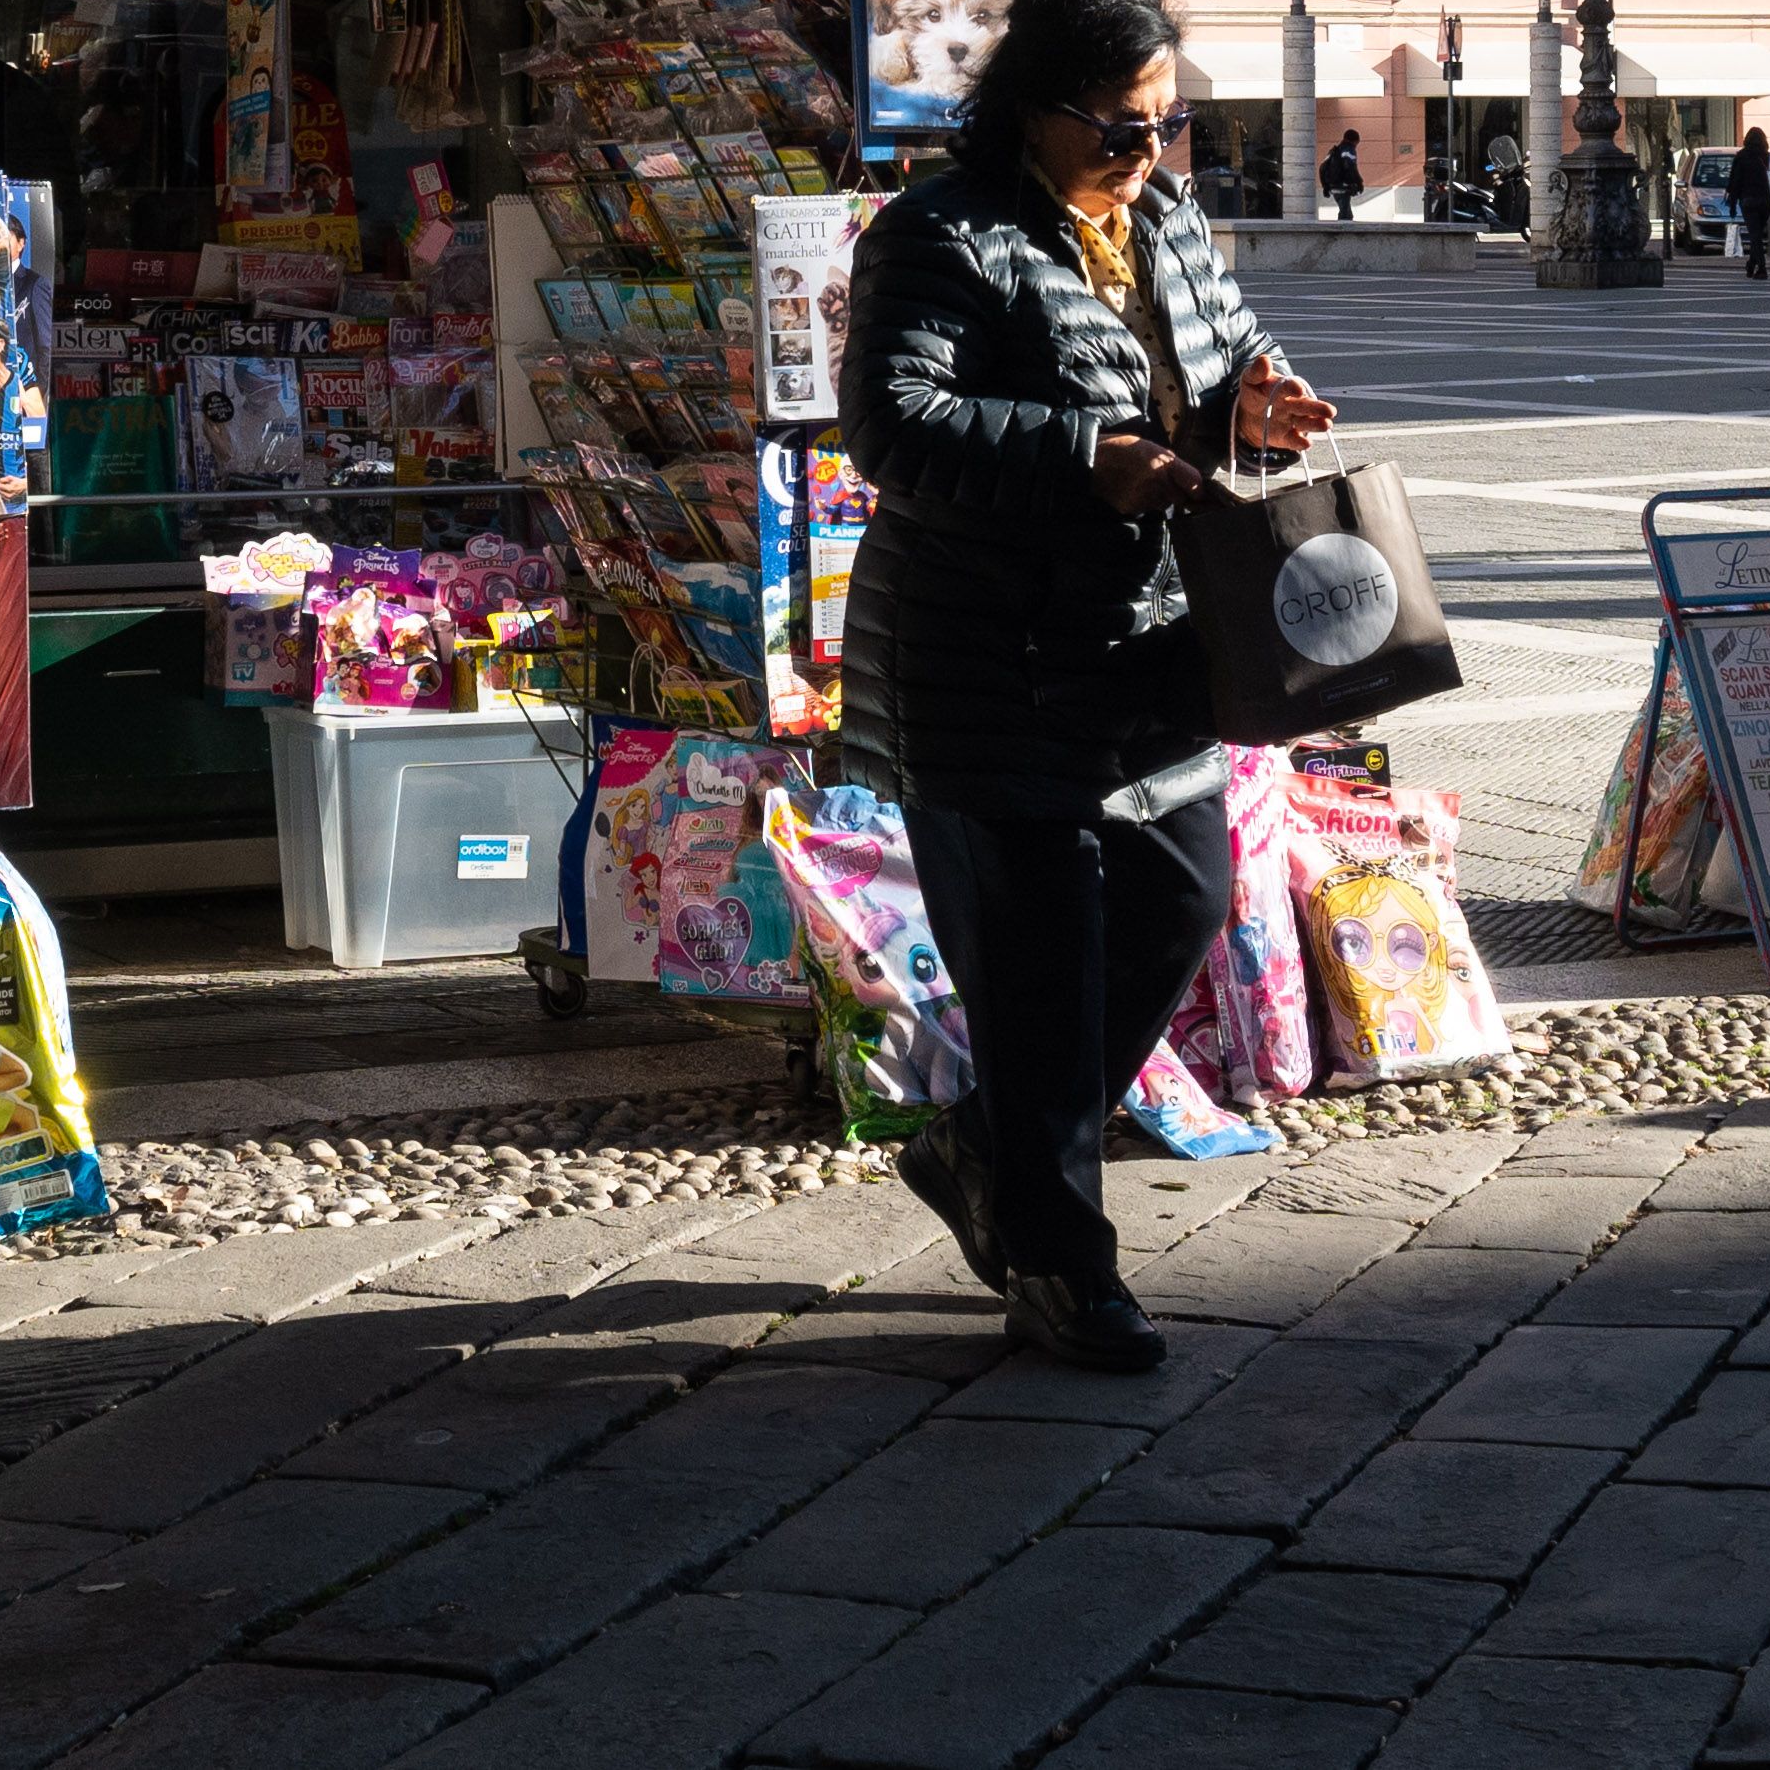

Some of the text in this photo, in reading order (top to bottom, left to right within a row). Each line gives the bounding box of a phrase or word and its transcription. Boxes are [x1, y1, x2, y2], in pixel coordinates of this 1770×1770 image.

[763, 206, 842, 218] CALENDARIO 2025
[763, 222, 827, 241] GATTI
[765, 246, 829, 260] marachelle
[132, 259, 166, 278] 中意
[74, 298, 112, 310] FOOD
[1280, 572, 1387, 626] CROFF
[1720, 664, 1761, 683] SCAVI
[460, 843, 507, 856] ordibox
[1349, 836, 1400, 854] style
